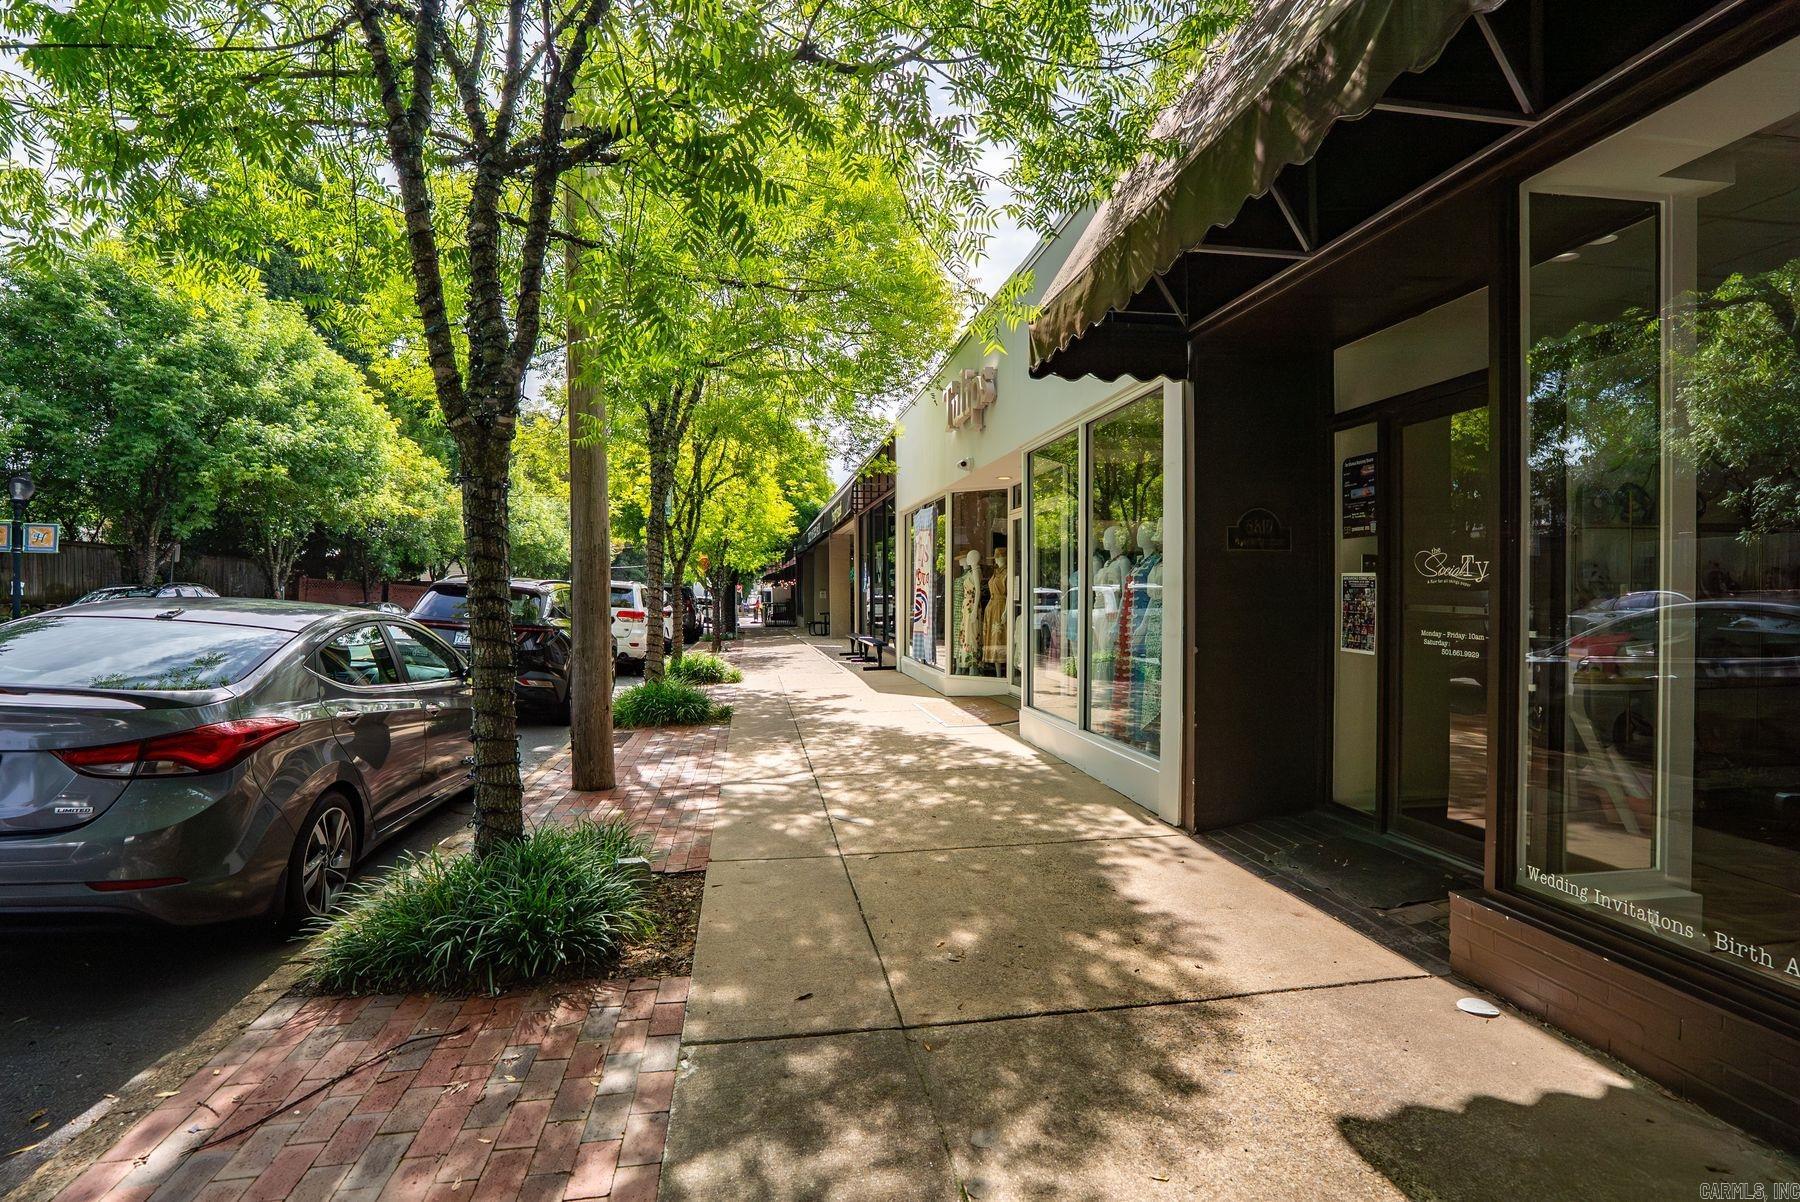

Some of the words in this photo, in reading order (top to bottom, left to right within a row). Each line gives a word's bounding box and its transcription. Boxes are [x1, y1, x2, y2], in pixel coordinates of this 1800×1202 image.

[1421, 630, 1442, 638] Monday
[1468, 633, 1485, 641] 10am
[1527, 864, 1589, 903] Wedding
[1593, 888, 1695, 939] Invitations
[1713, 930, 1775, 970] Birth
